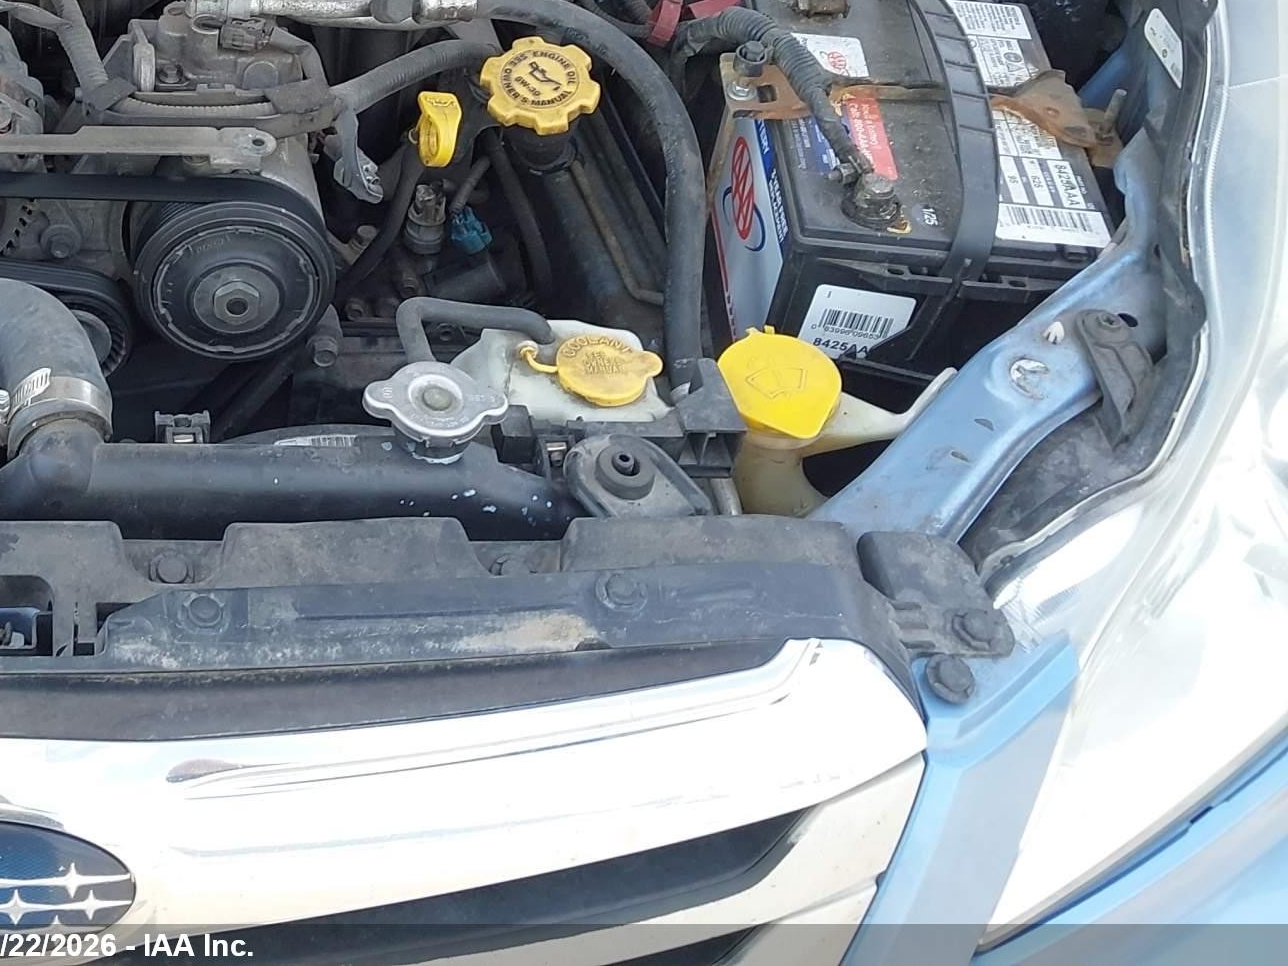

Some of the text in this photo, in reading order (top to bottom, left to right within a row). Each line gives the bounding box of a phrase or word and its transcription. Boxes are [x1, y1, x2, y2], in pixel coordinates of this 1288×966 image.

[532, 50, 577, 85] ENGINE OIL
[530, 90, 573, 106] MANUAL
[1054, 164, 1081, 206] 8425AAA
[921, 208, 939, 226] 1/25
[562, 336, 633, 357] COOLANT
[813, 337, 871, 355] 8425AA
